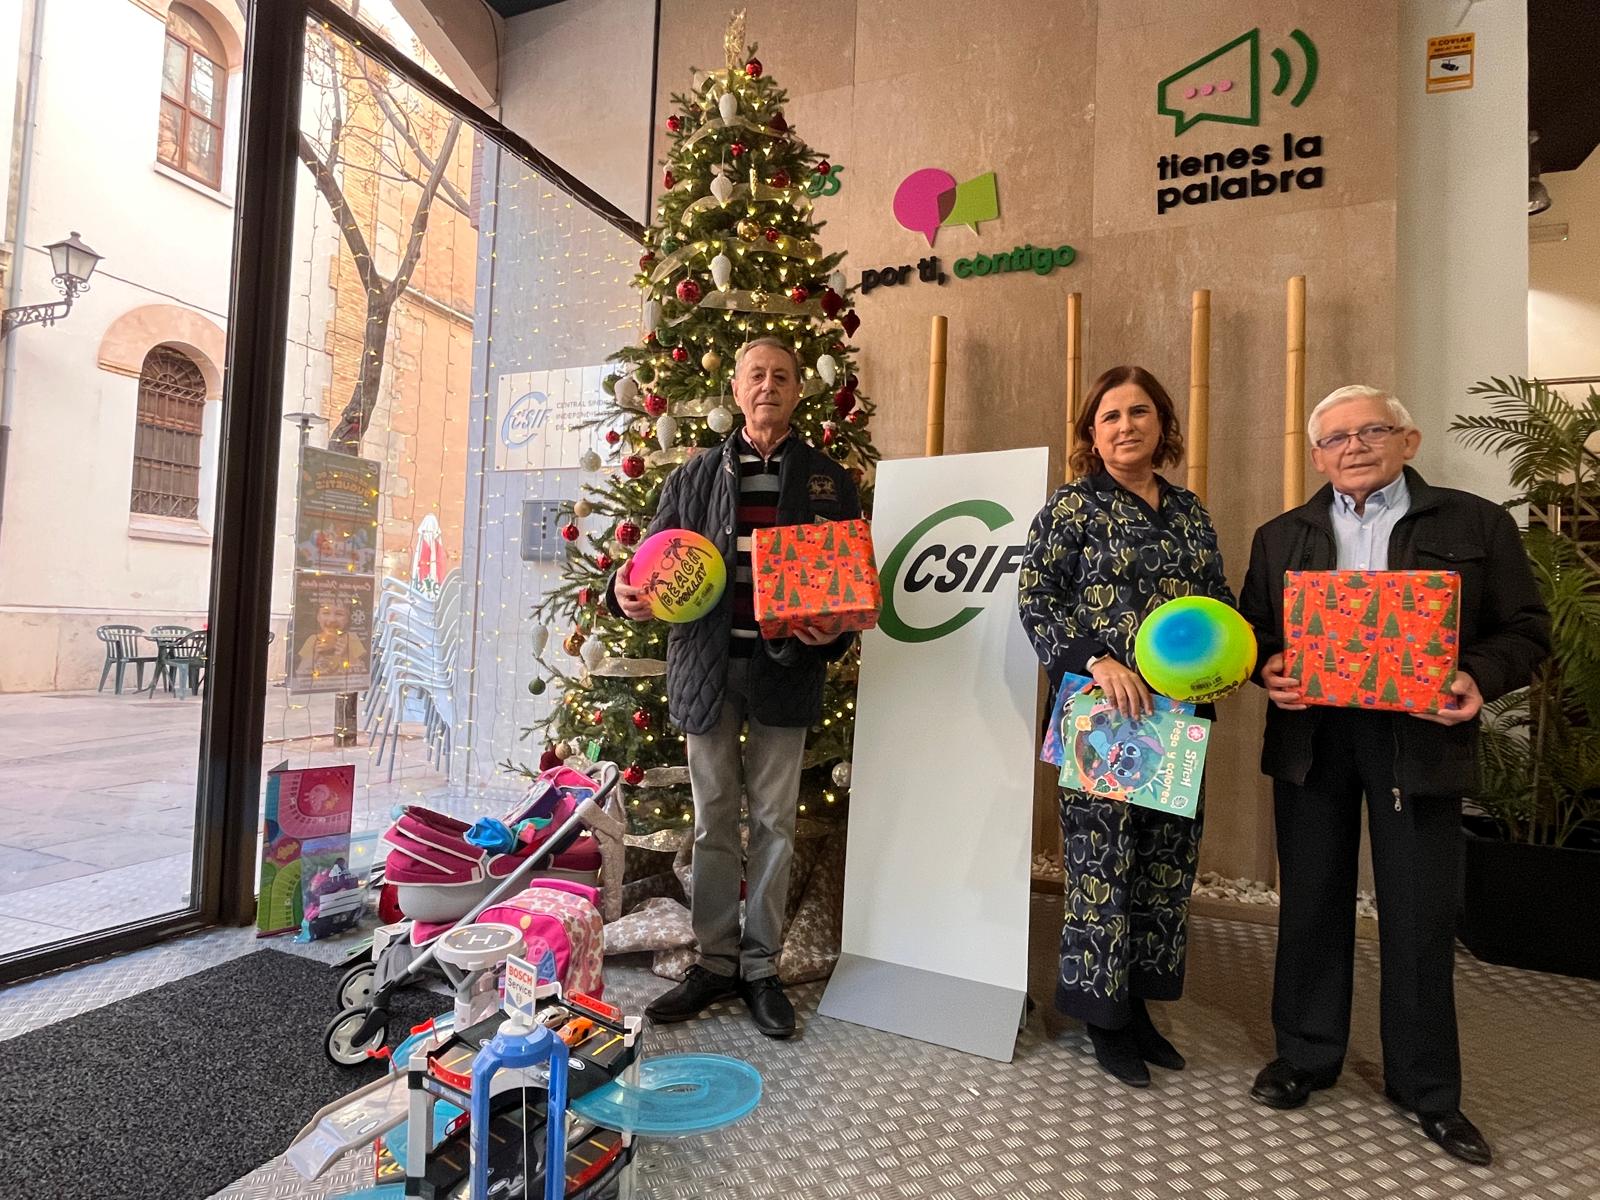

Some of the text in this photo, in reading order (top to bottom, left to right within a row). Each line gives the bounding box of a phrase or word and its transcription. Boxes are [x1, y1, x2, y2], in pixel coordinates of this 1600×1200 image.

[1157, 132, 1323, 181] tienes la
[1157, 166, 1324, 215] palabra
[861, 243, 1076, 295] por ti, contigo
[511, 408, 553, 430] CSIF
[660, 547, 701, 607] BEACH
[675, 562, 707, 607] VOLLEY
[903, 544, 1027, 593] CSIF
[1159, 761, 1174, 805] colorea
[507, 977, 533, 998] Service
[508, 964, 534, 987] BOSCH
